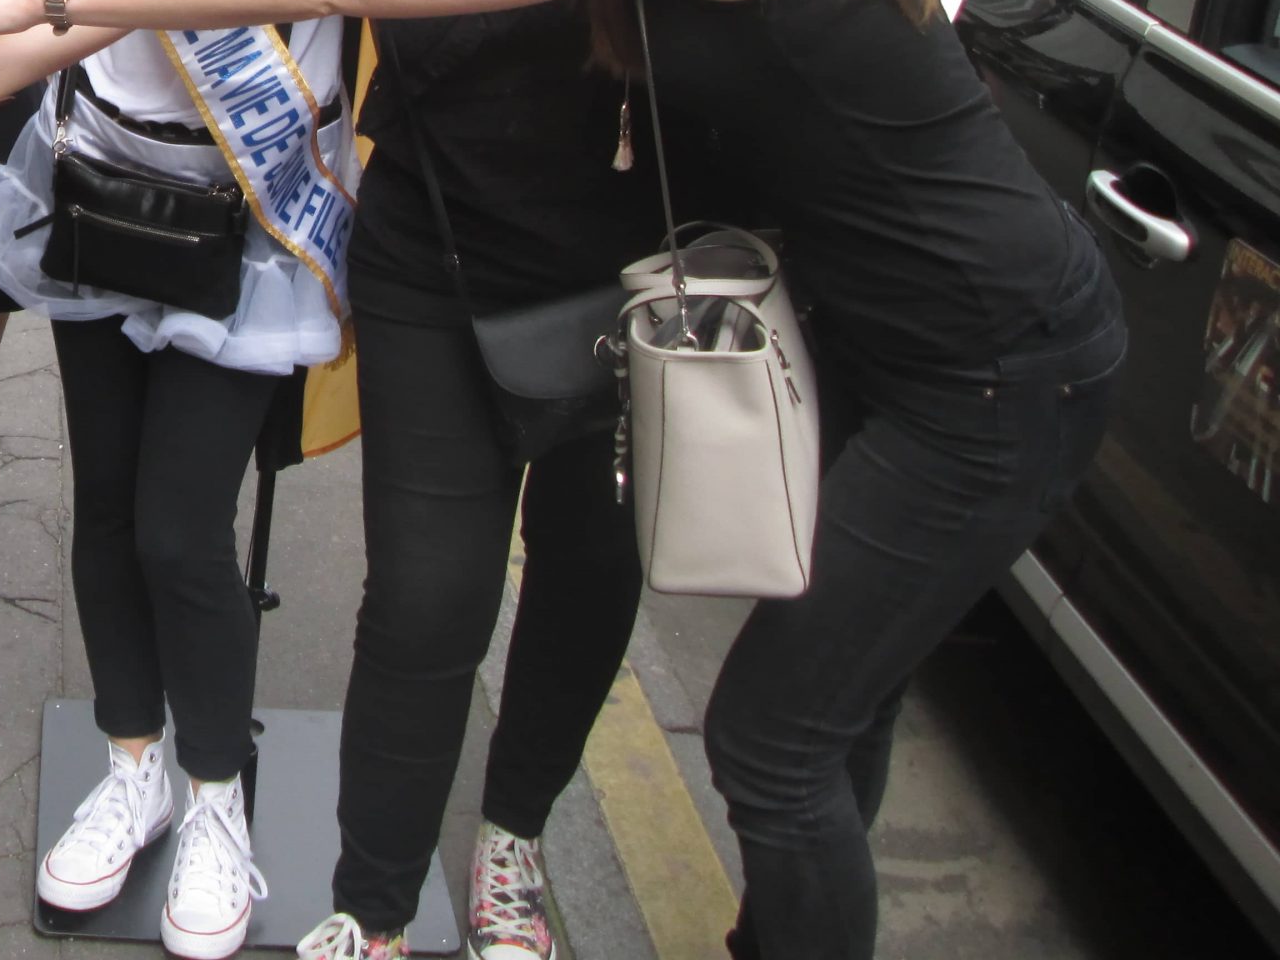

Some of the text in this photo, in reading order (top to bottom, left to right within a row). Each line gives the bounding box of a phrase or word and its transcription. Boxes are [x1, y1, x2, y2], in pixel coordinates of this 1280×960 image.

[194, 26, 262, 90] MA
[220, 64, 290, 130] VIE
[241, 107, 307, 168] DE
